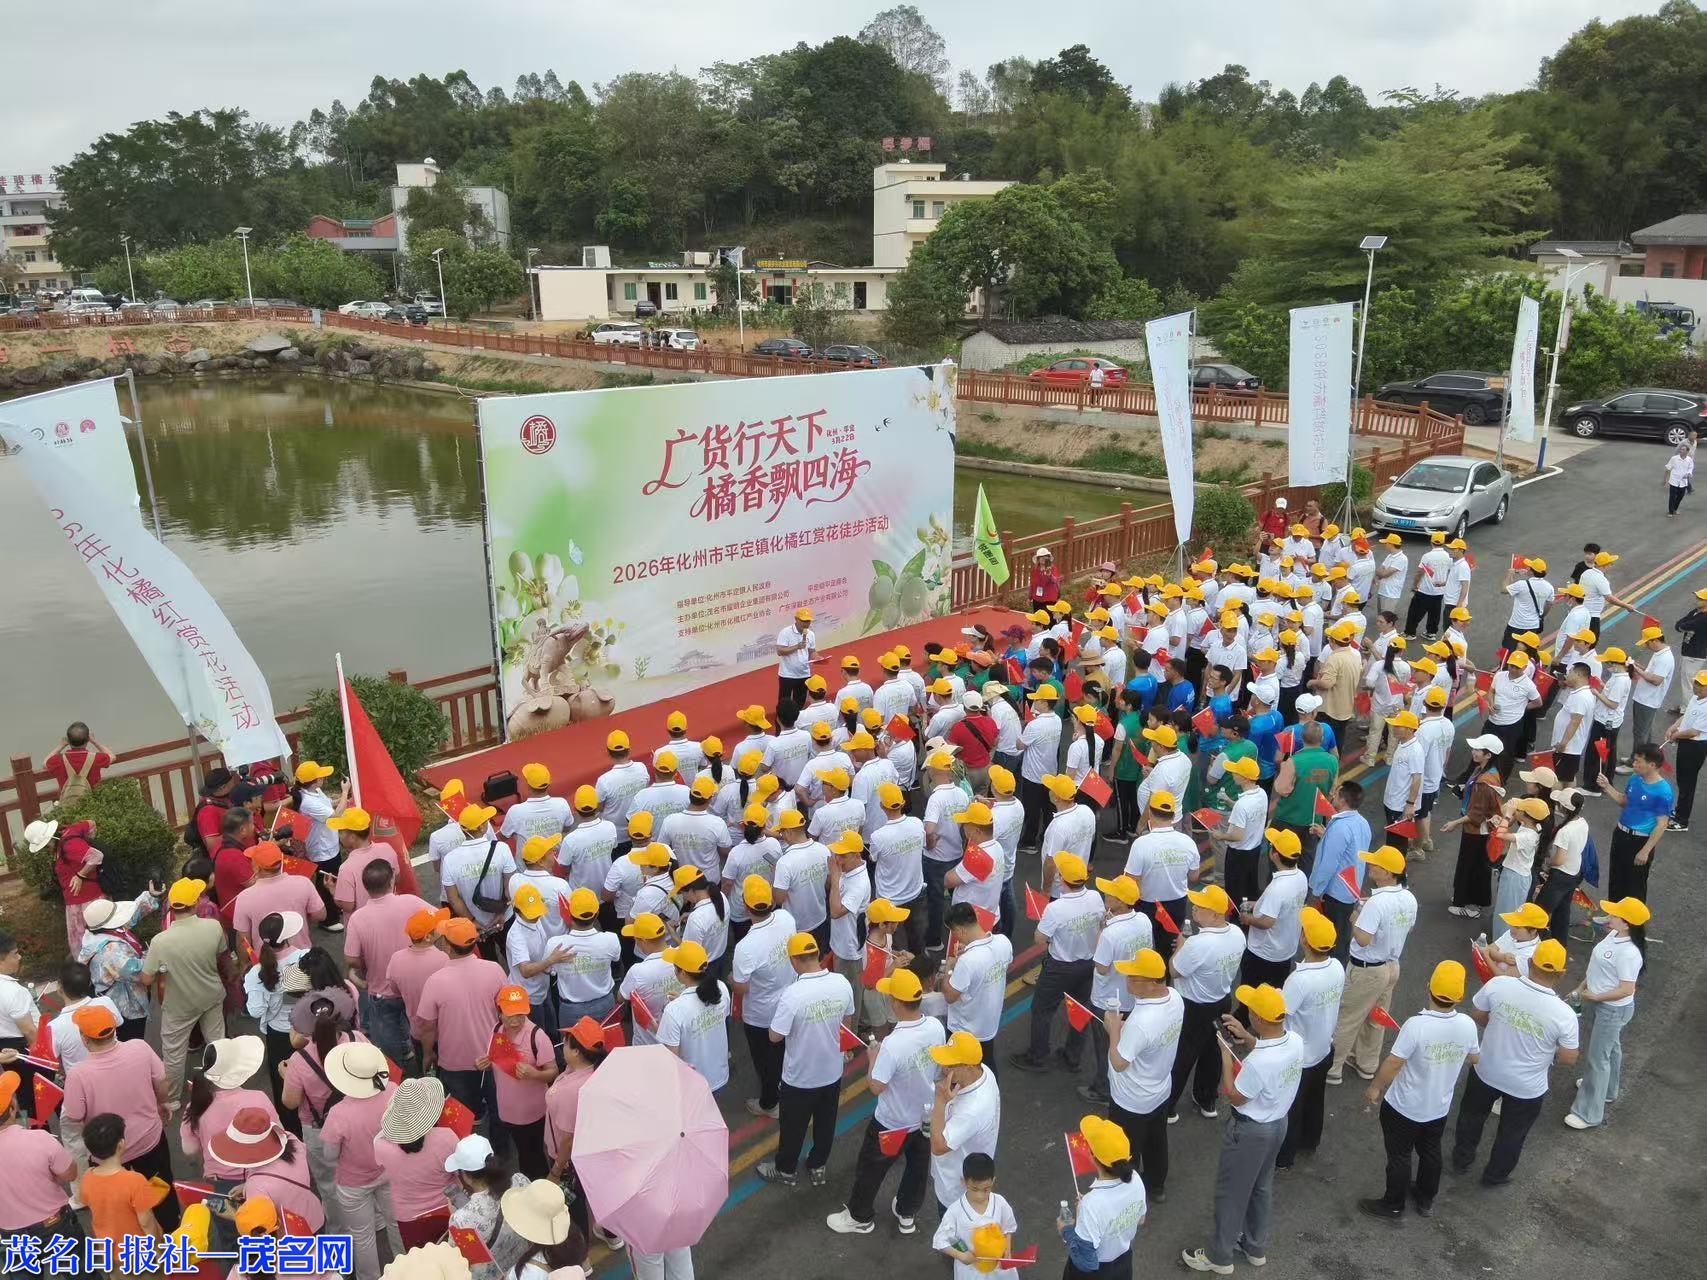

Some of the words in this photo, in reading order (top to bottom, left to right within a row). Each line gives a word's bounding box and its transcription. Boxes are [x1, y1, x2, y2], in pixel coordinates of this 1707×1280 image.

[642, 408, 829, 497] 广货行天下
[689, 446, 872, 523] 橘香飘四海
[612, 514, 890, 585] 2026年化州市平定镇化橘红赏花徒步活动
